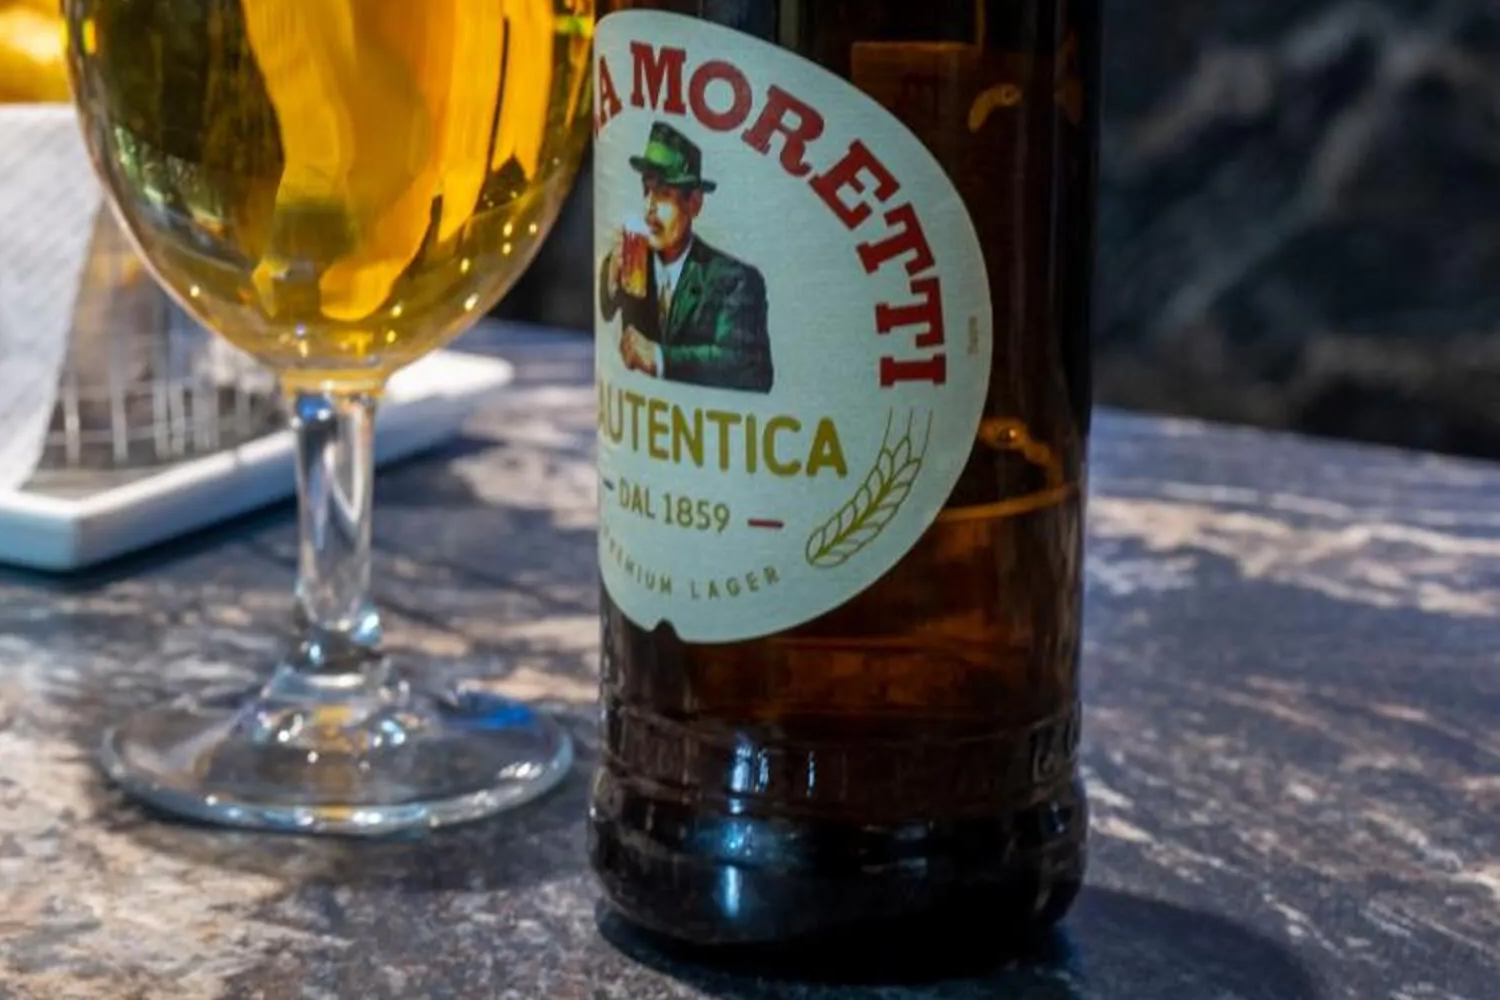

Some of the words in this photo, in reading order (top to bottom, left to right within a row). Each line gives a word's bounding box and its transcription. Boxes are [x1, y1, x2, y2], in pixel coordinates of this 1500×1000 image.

[630, 41, 946, 388] MORETTI
[619, 477, 654, 520] DAL
[664, 492, 730, 534] 1859
[690, 565, 779, 600] LAGER
